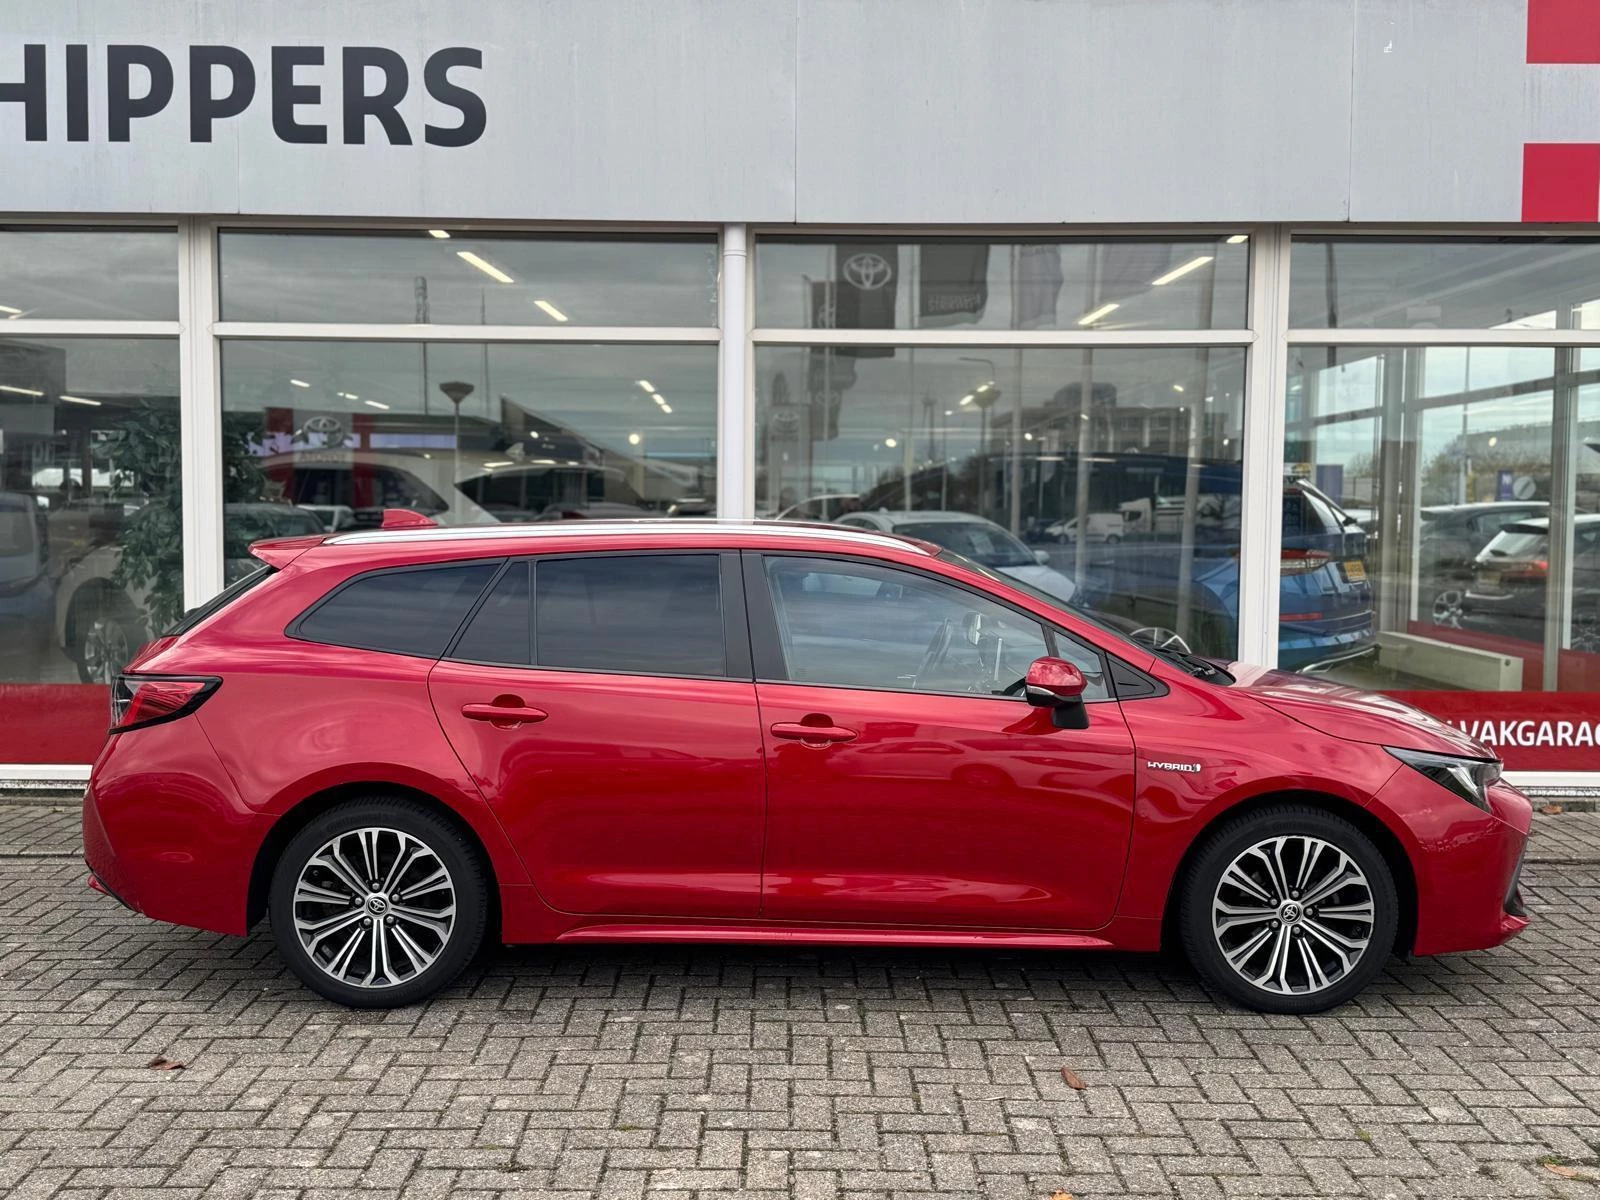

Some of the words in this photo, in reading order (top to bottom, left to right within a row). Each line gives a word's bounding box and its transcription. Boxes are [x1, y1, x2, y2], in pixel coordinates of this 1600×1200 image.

[0, 44, 487, 147] HIPPERS
[1460, 720, 1600, 747] VAKGARA
[1147, 761, 1193, 772] HYBRID
